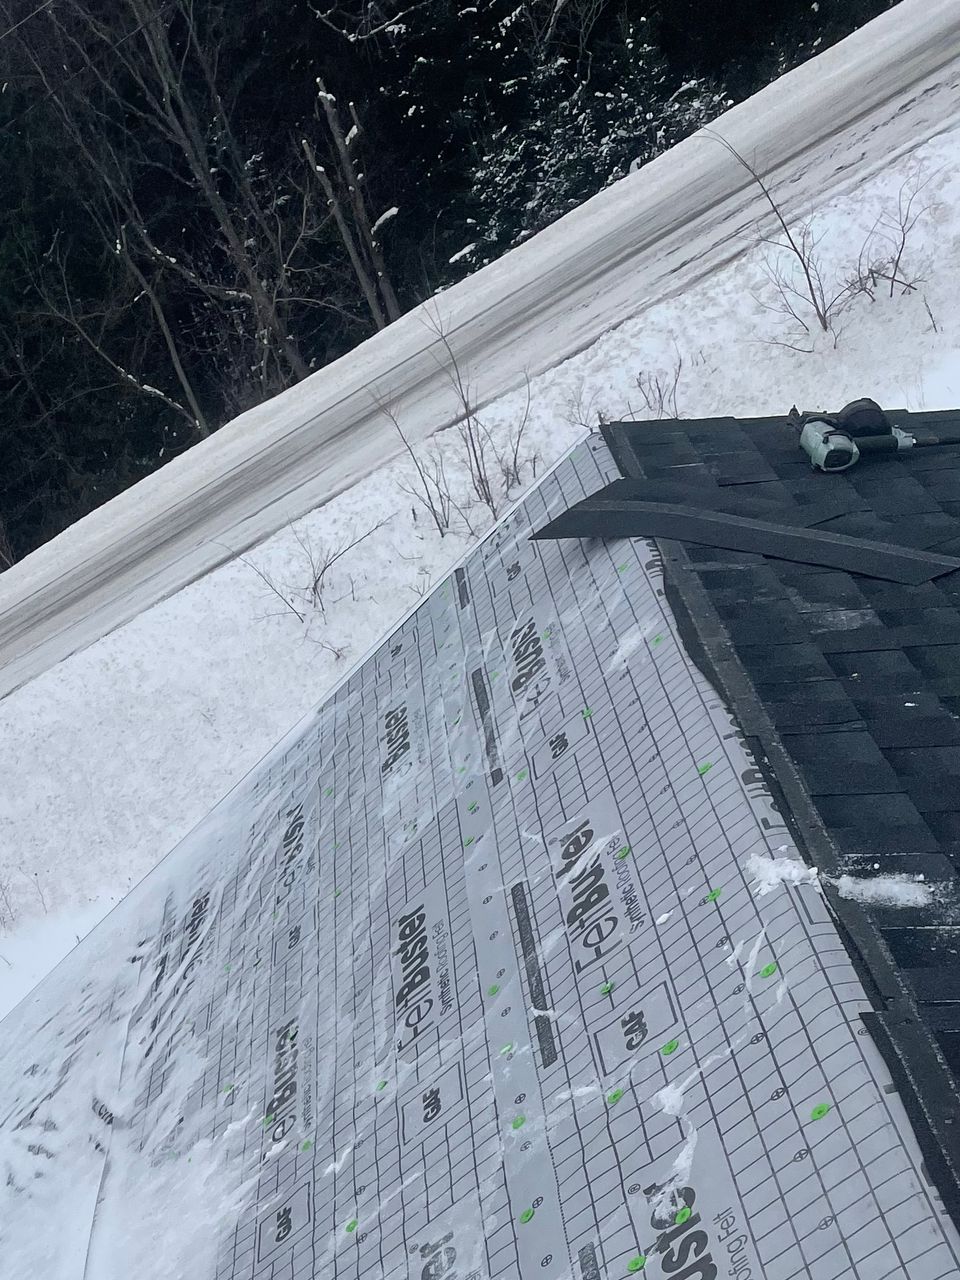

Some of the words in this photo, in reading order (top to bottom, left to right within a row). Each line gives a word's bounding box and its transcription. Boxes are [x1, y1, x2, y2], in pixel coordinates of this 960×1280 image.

[548, 731, 569, 760] GAF
[392, 903, 434, 1052] FeltBuster
[621, 1008, 649, 1051] GAF
[422, 1087, 442, 1123] GAF
[275, 1206, 292, 1243] GAF
[711, 1205, 739, 1240] Felt
